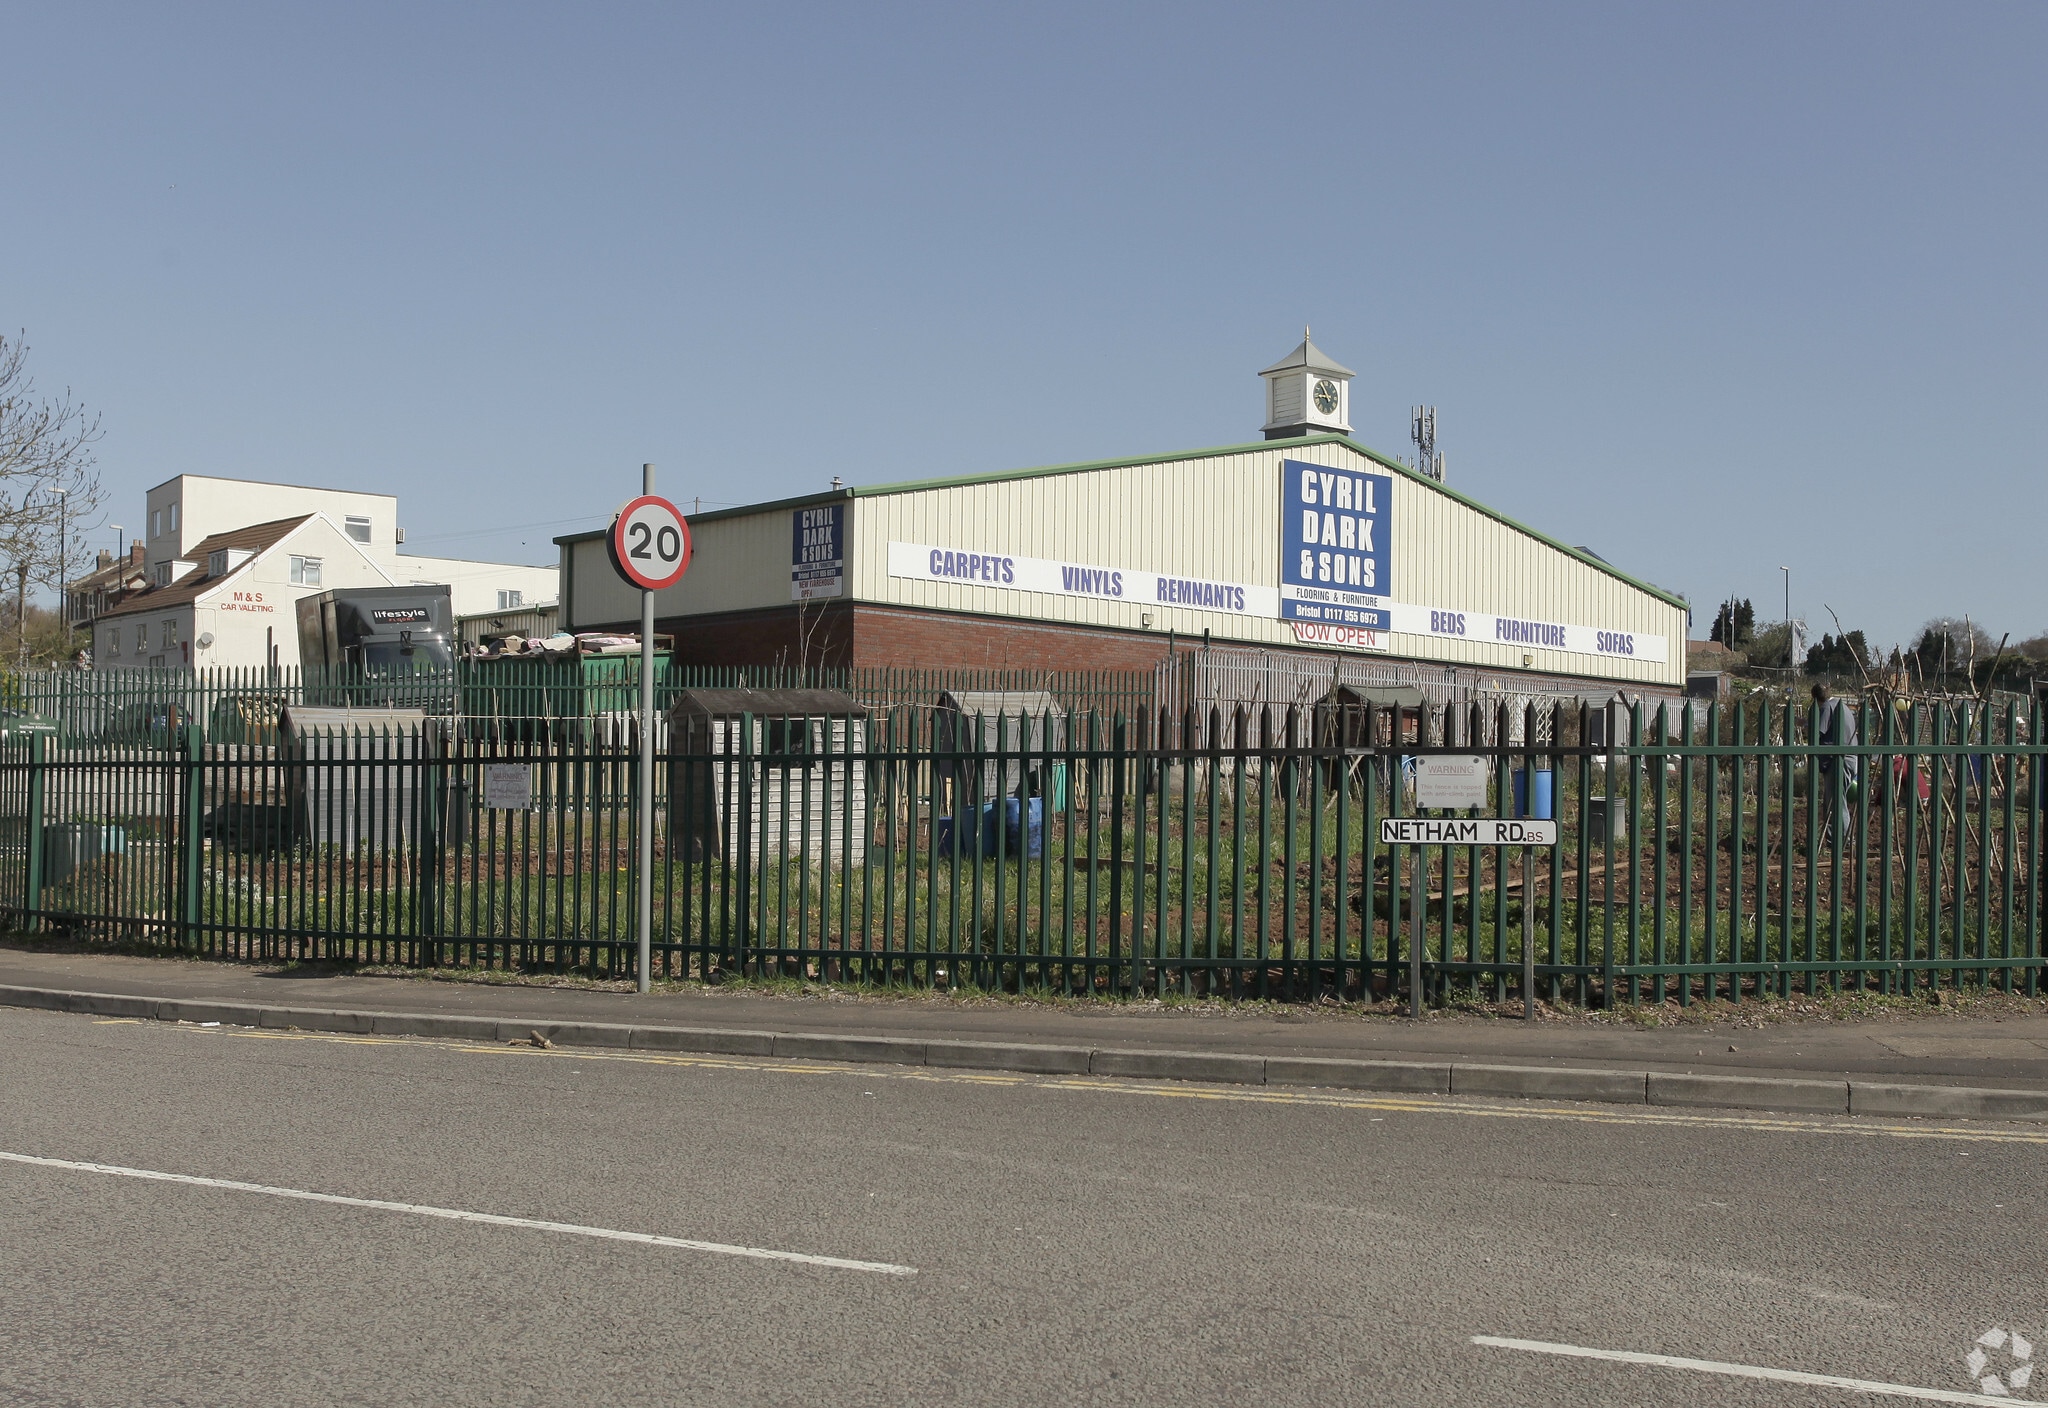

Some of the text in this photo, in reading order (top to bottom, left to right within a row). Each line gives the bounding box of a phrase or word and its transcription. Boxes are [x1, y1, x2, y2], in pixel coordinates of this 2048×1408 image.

[1300, 470, 1377, 514] CYRIL
[802, 507, 833, 528] CYRIL
[629, 522, 680, 562] 20
[802, 526, 832, 547] DARK
[1302, 509, 1374, 552] DARK
[802, 544, 833, 562] & SONS
[929, 549, 1014, 584] CARPETS
[1300, 549, 1376, 588] & SONS
[1062, 565, 1124, 597] VINYLS
[234, 592, 263, 602] M & S
[1156, 577, 1245, 611] REMNANTS
[1296, 588, 1378, 607] FLOORING & FURNITURE
[239, 604, 274, 612] VALETING
[374, 610, 426, 618] lifestyle
[1296, 604, 1378, 625] Bristol 0117 955 6973
[1294, 622, 1376, 646] NOW OPEN
[1430, 610, 1466, 636] BEDS
[1496, 618, 1566, 646] FURNITURE
[1596, 631, 1634, 655] SOFAS
[1428, 765, 1474, 774] WARNING
[1384, 822, 1478, 842] NETHAM
[1527, 832, 1544, 842] BS
